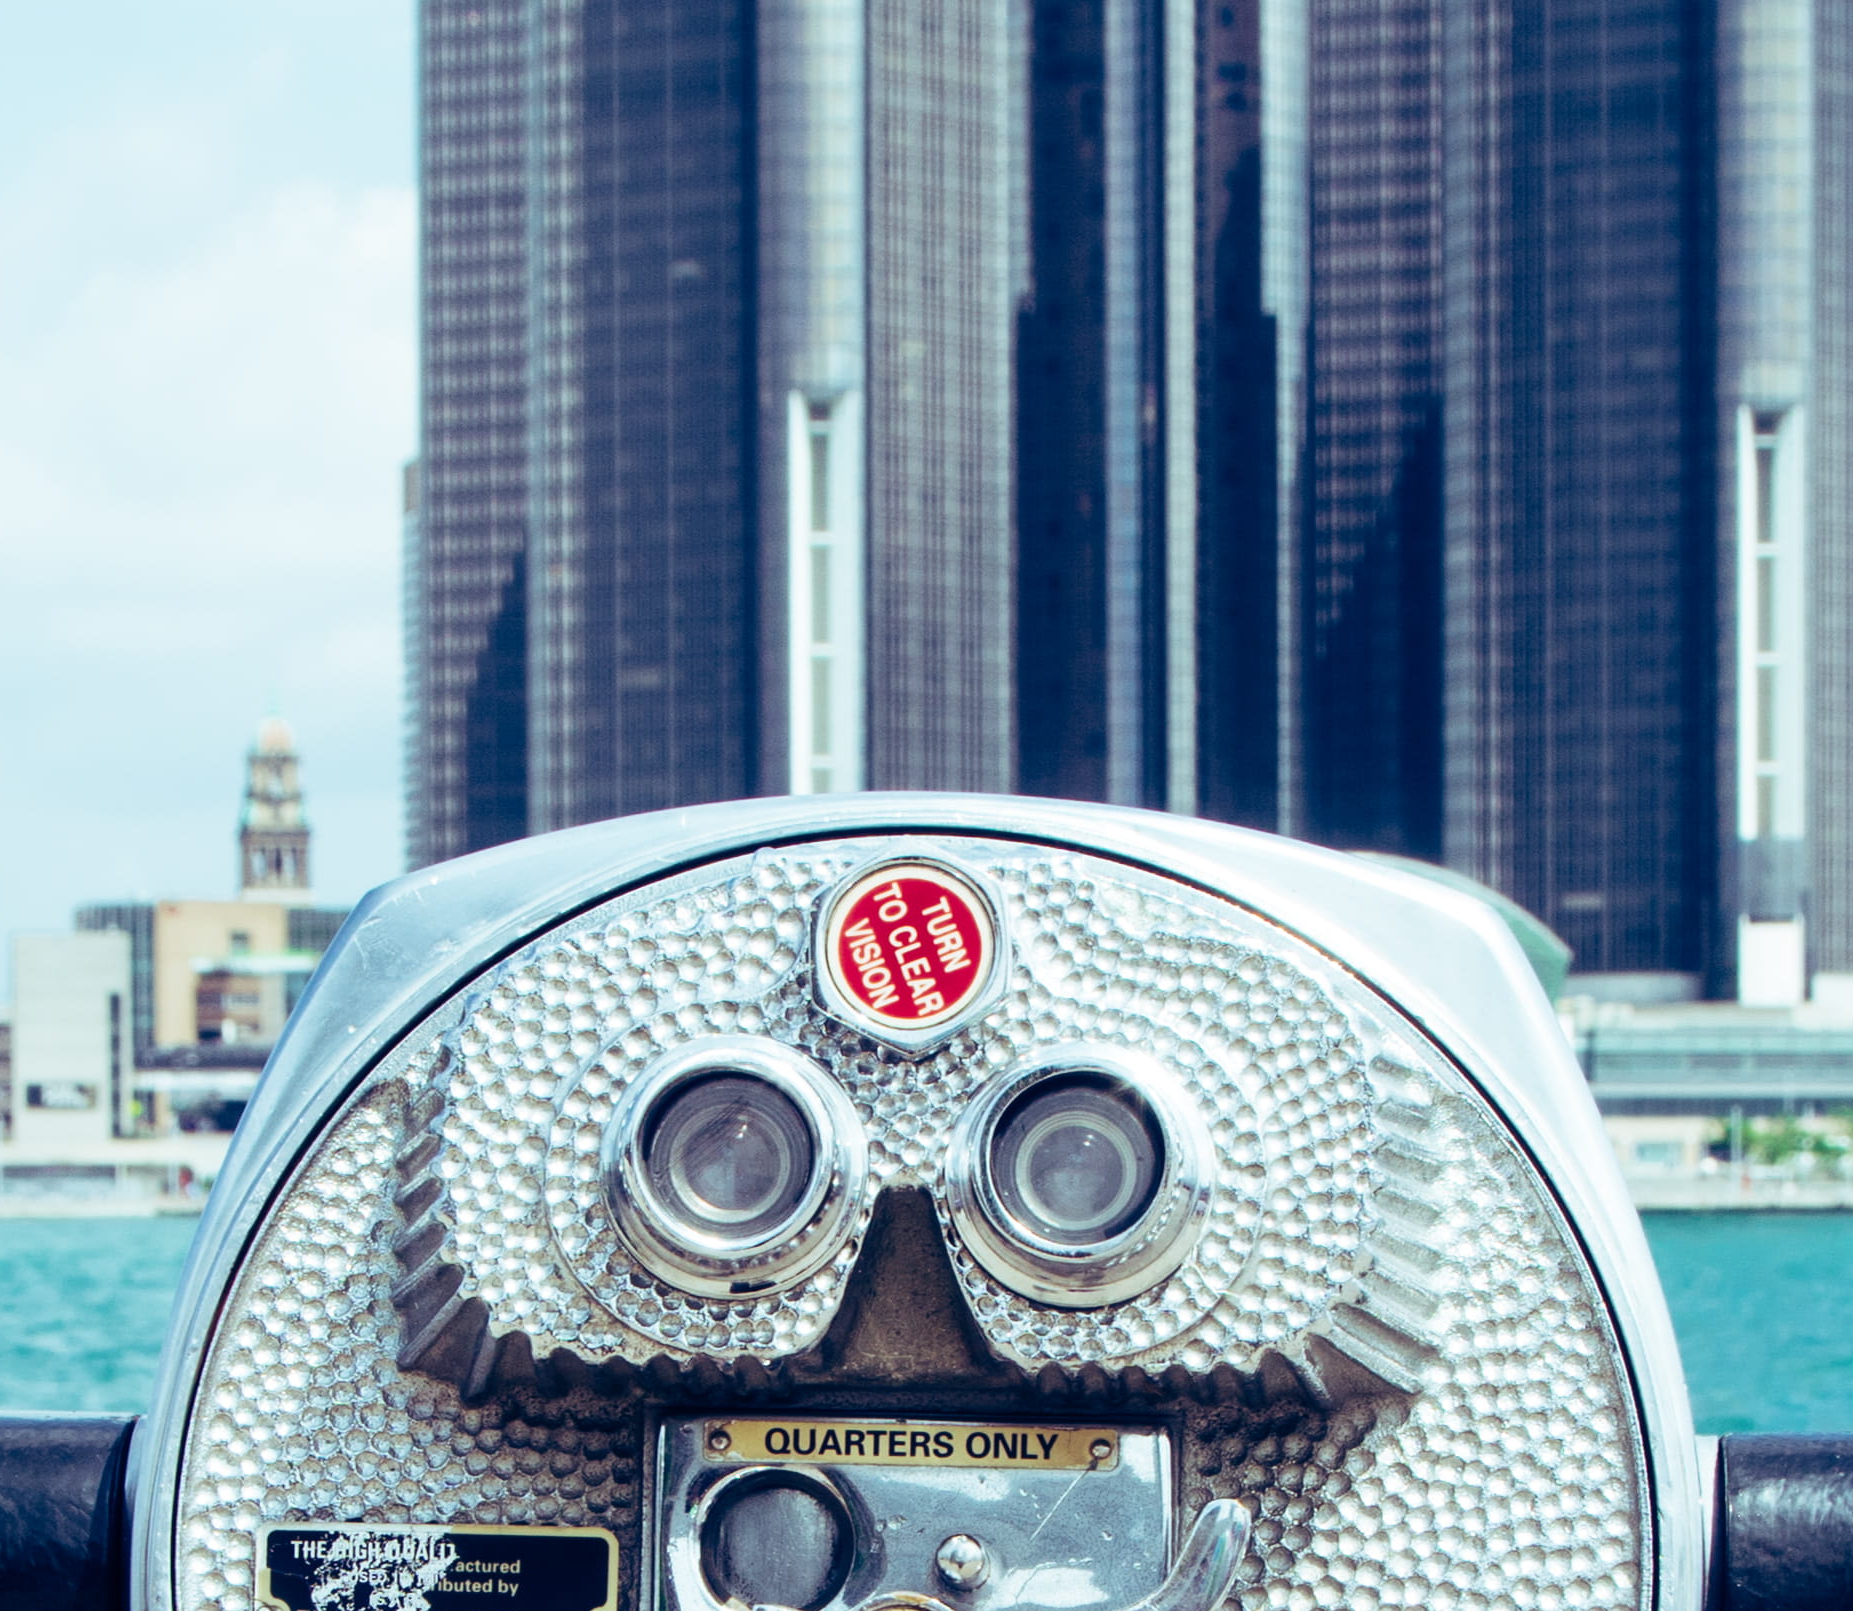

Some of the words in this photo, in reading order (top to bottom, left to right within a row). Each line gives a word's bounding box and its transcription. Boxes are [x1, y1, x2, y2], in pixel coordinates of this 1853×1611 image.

[873, 883, 908, 923] TO
[921, 896, 971, 973] TURN
[844, 918, 899, 1008] VISION
[888, 925, 944, 1015] CLEAR
[765, 1428, 953, 1458] QUARTERS
[966, 1432, 1059, 1459] ONLY
[291, 1541, 326, 1559] THE
[498, 1580, 518, 1597] by
